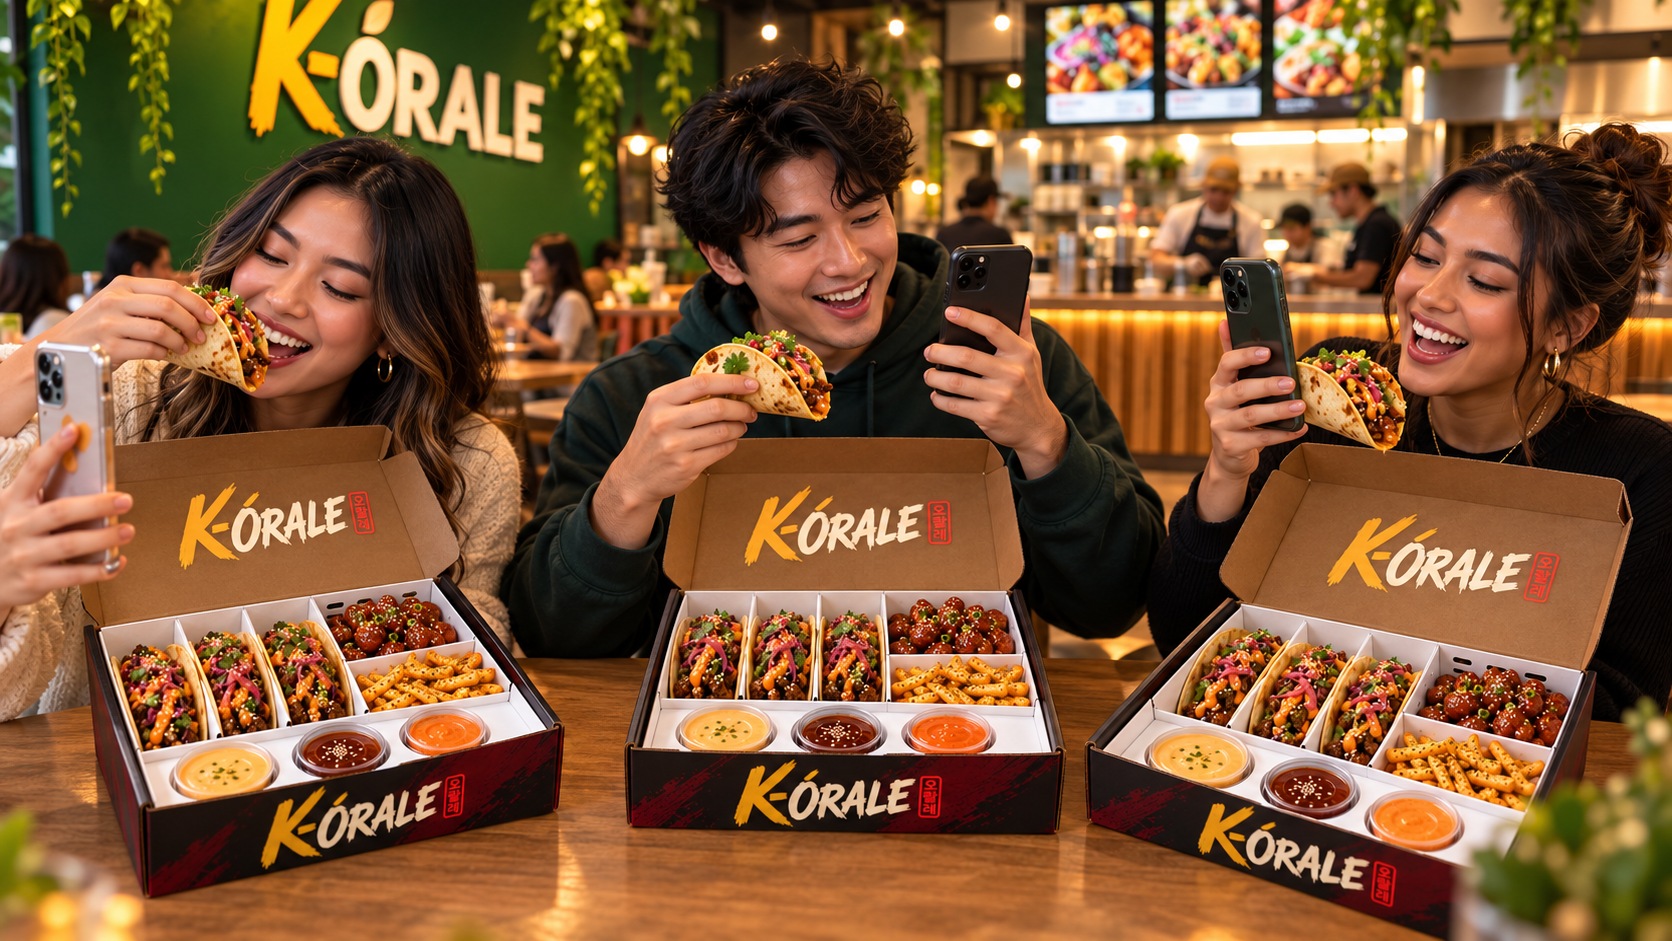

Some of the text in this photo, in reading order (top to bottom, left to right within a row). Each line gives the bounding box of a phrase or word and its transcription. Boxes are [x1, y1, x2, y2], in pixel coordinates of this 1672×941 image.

[248, 0, 545, 163] K-ÓRALE
[179, 482, 349, 569] K-ÓRALE
[744, 485, 924, 566] K-ÓRALE
[1327, 513, 1532, 593] K-ÓRALE
[260, 780, 442, 869] K-ÓRALE
[734, 759, 916, 827] K-ÓRALE
[1198, 803, 1370, 891] K-ÓRALE
